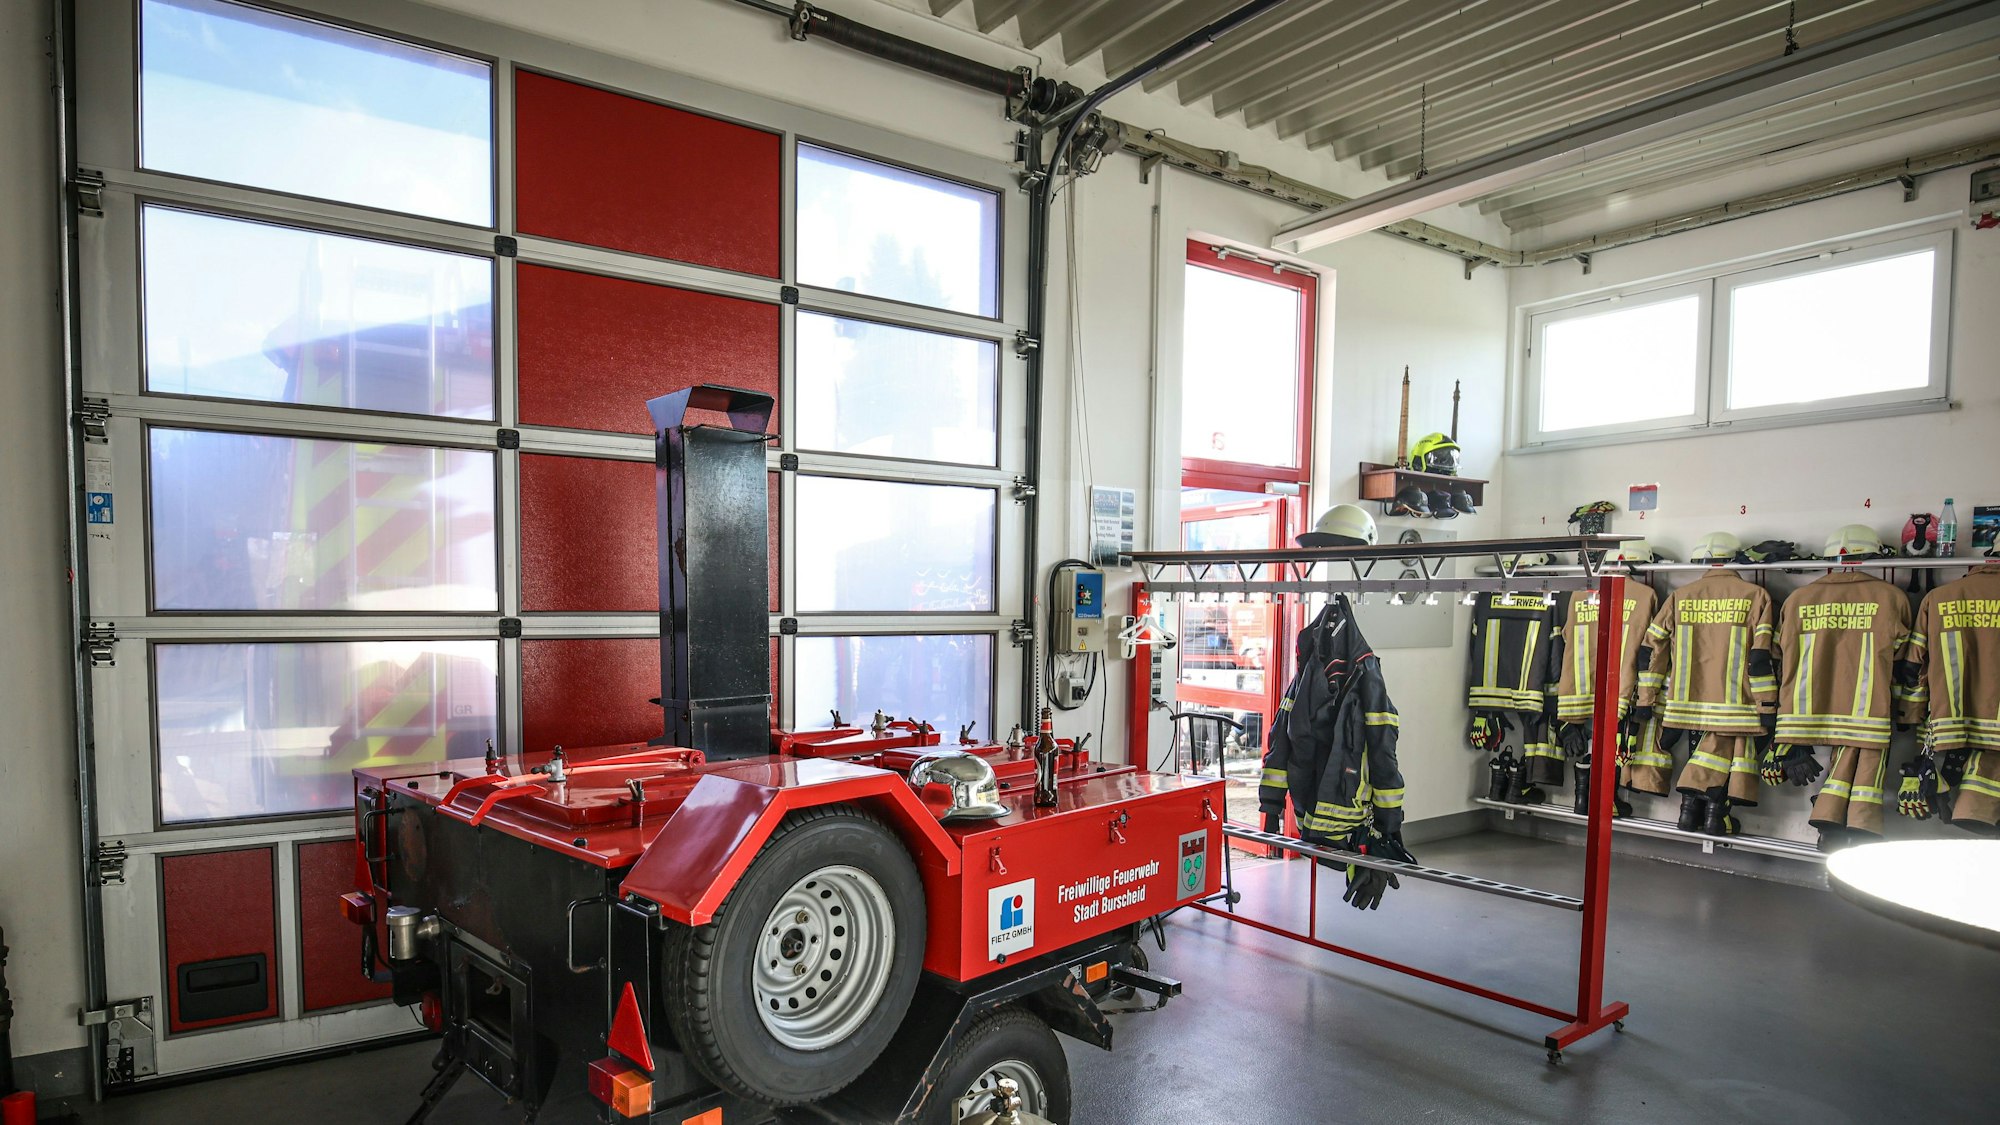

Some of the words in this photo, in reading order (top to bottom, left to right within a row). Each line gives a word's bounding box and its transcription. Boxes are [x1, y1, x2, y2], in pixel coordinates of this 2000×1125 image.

[1740, 505, 1746, 515] 3
[1864, 498, 1871, 508] 4
[1640, 511, 1645, 520] 2
[1679, 599, 1752, 612] FEUERWEHR
[1799, 603, 1879, 618] FEUERWEHR
[1681, 611, 1746, 623] BURSCHEID
[1803, 616, 1872, 631] BURSCHEID
[1058, 875, 1110, 903] Freiwillige
[1113, 860, 1160, 887] Feuerwehr
[1073, 899, 1100, 923] Stadt
[1101, 885, 1146, 914] Burscheid
[991, 932, 1011, 945] FIETZ
[1011, 925, 1032, 938] GMBH
